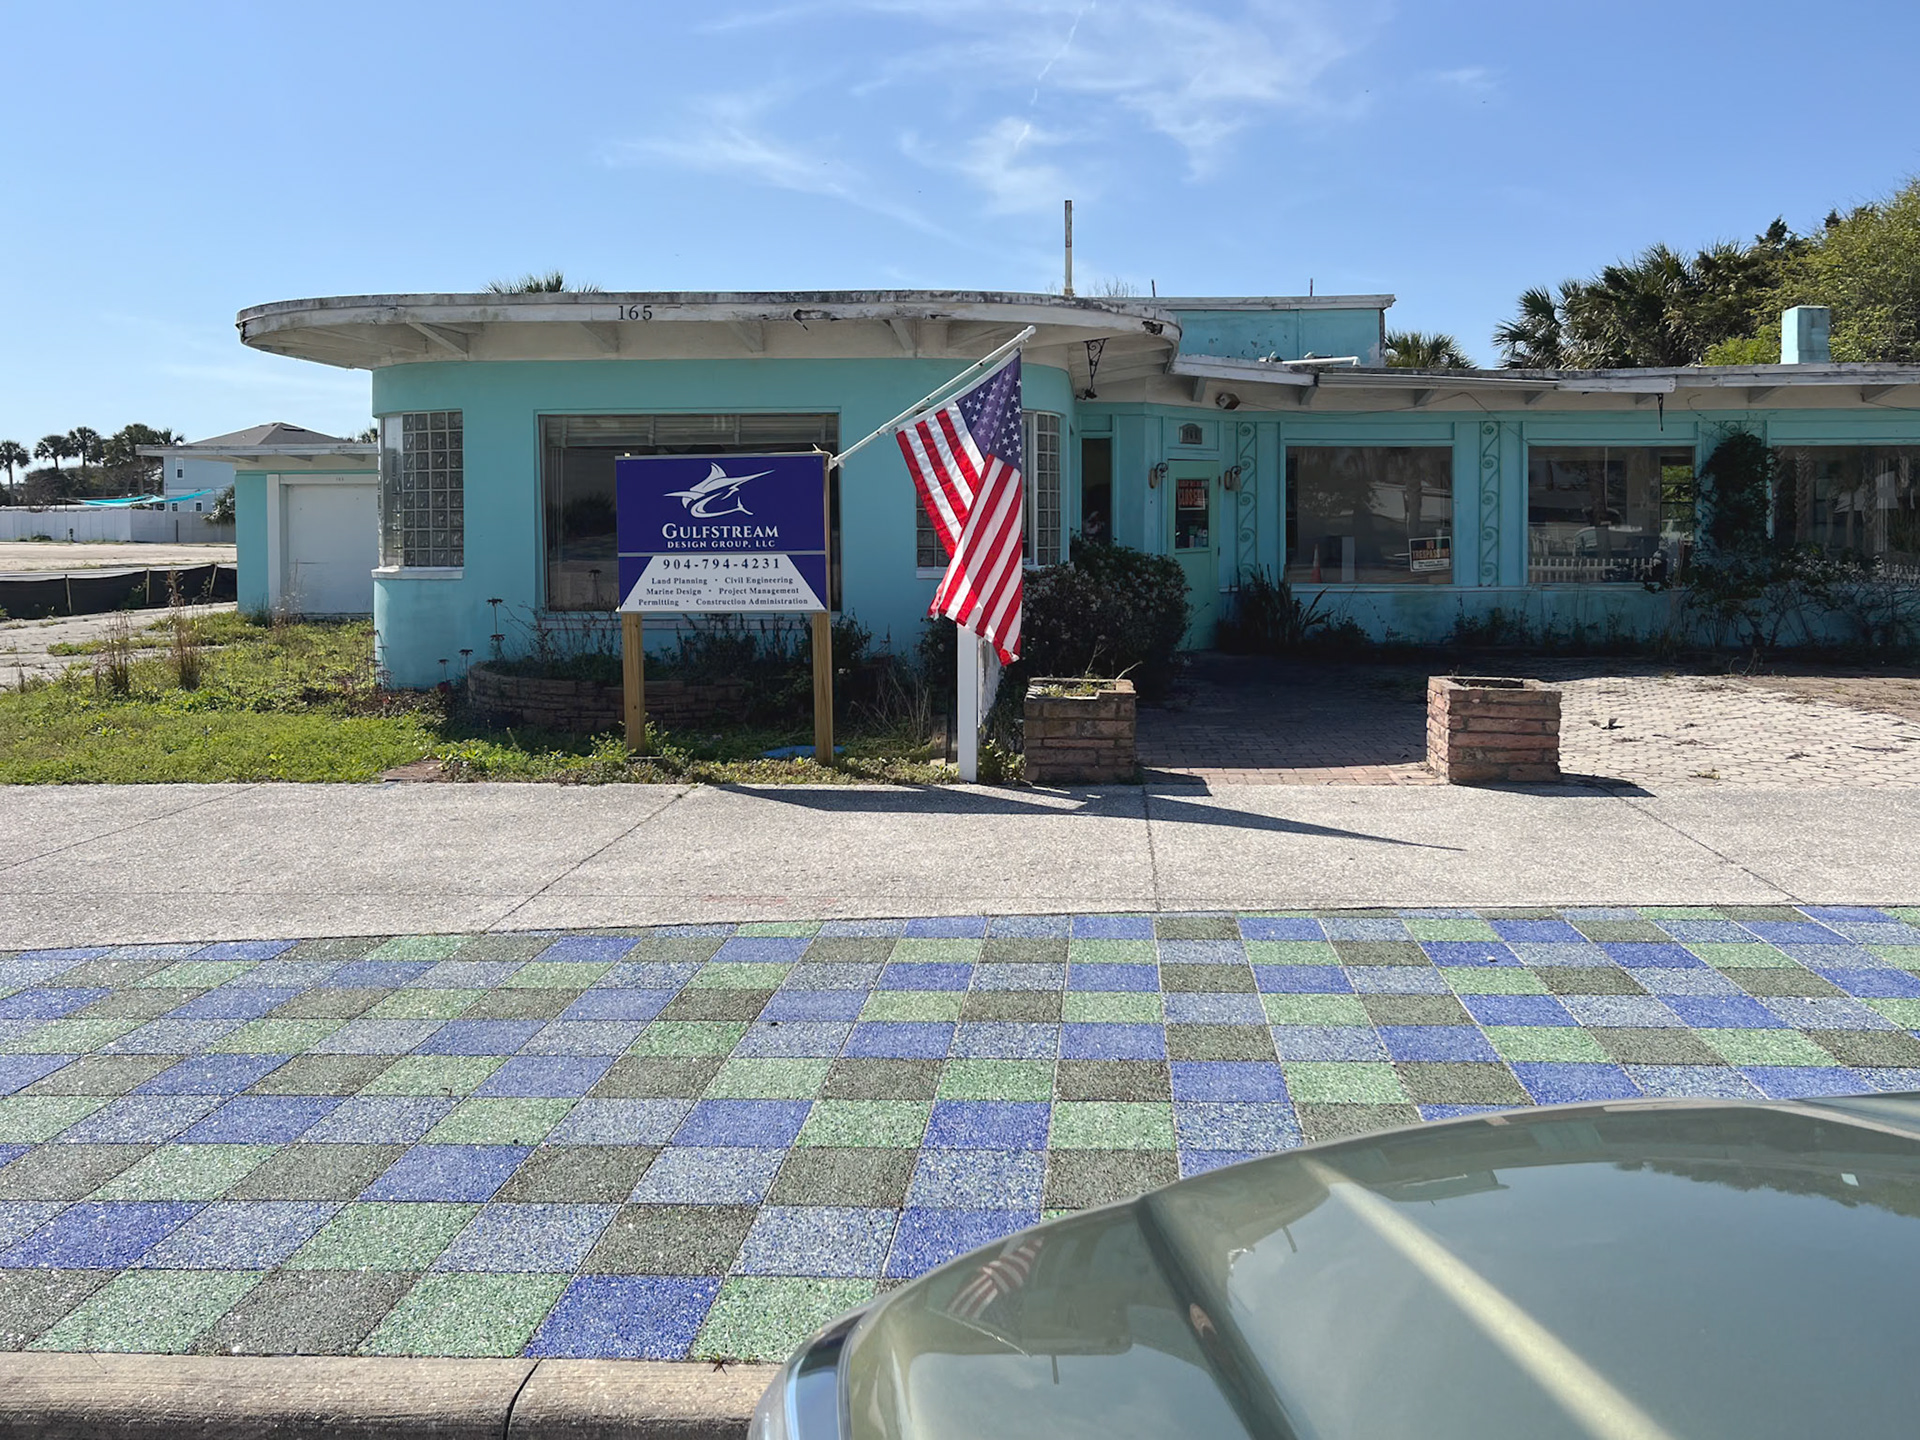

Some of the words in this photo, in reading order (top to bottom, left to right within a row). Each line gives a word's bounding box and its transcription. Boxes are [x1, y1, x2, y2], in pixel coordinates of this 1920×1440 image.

[618, 305, 652, 320] 165
[662, 523, 778, 539] GULFSTREAM
[663, 558, 779, 570] 904-794-4231
[676, 588, 701, 596] Design
[719, 588, 747, 596] Project
[750, 587, 799, 595] Management
